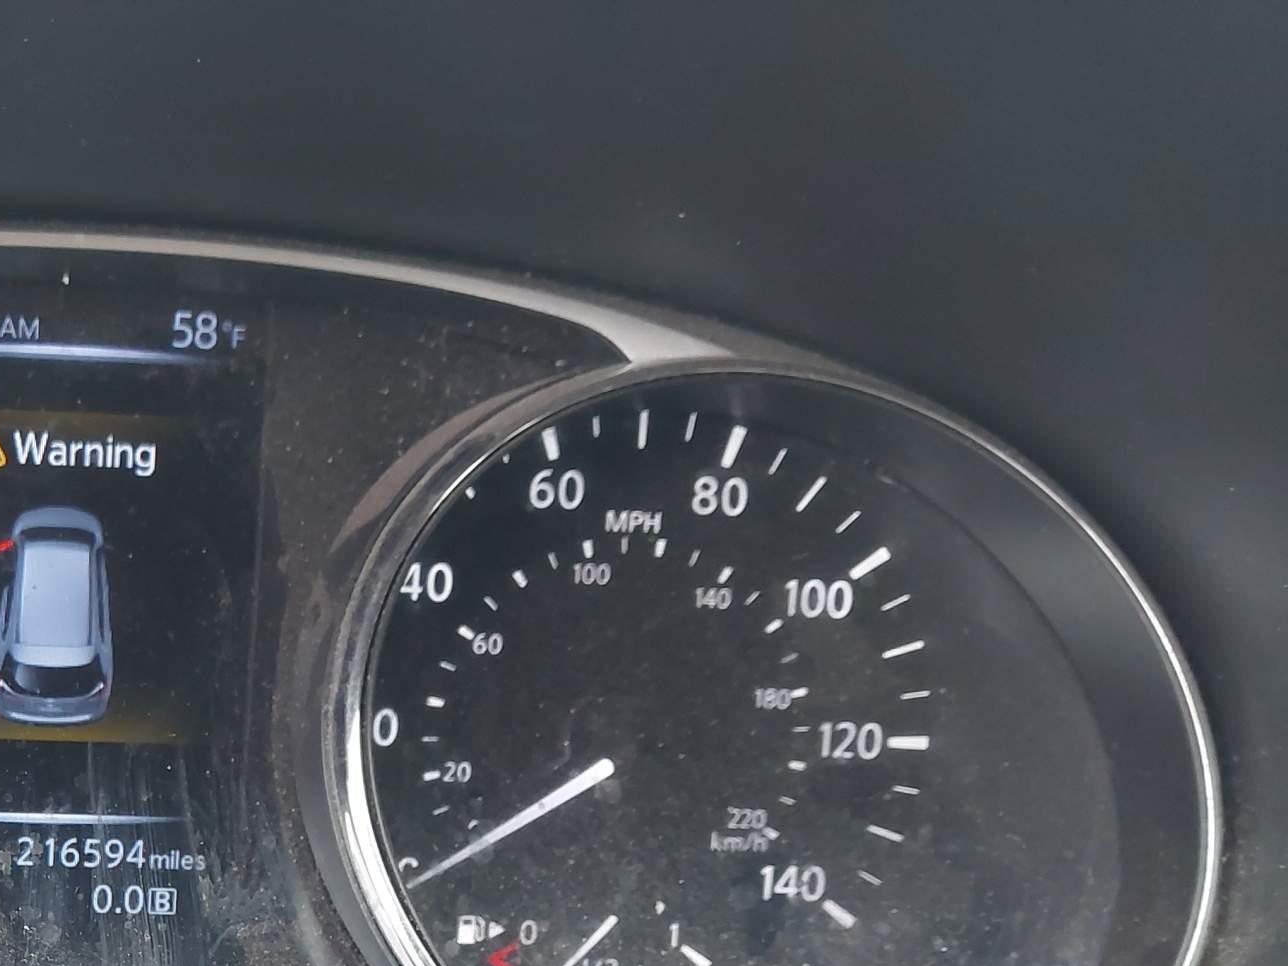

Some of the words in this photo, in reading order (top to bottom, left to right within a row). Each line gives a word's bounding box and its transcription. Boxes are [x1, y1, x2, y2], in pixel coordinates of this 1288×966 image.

[0, 316, 40, 340] AM
[13, 430, 156, 477] Warning
[529, 469, 585, 510] 60
[693, 476, 748, 517] 80
[604, 510, 662, 533] MPH
[400, 562, 453, 602] 40
[573, 563, 611, 585] 100
[695, 587, 732, 609] 140
[784, 579, 853, 619] 100
[473, 632, 503, 655] 60
[755, 688, 792, 710] 180
[373, 708, 399, 746] 0
[819, 723, 883, 760] 120
[442, 761, 472, 782] 20
[727, 807, 768, 829] 220
[17, 837, 145, 868] 216594
[150, 849, 206, 872] miles
[711, 831, 769, 853] km/h
[760, 865, 826, 902] 140
[93, 885, 143, 914] 0.0
[520, 920, 537, 945] 0
[669, 923, 681, 947] 1
